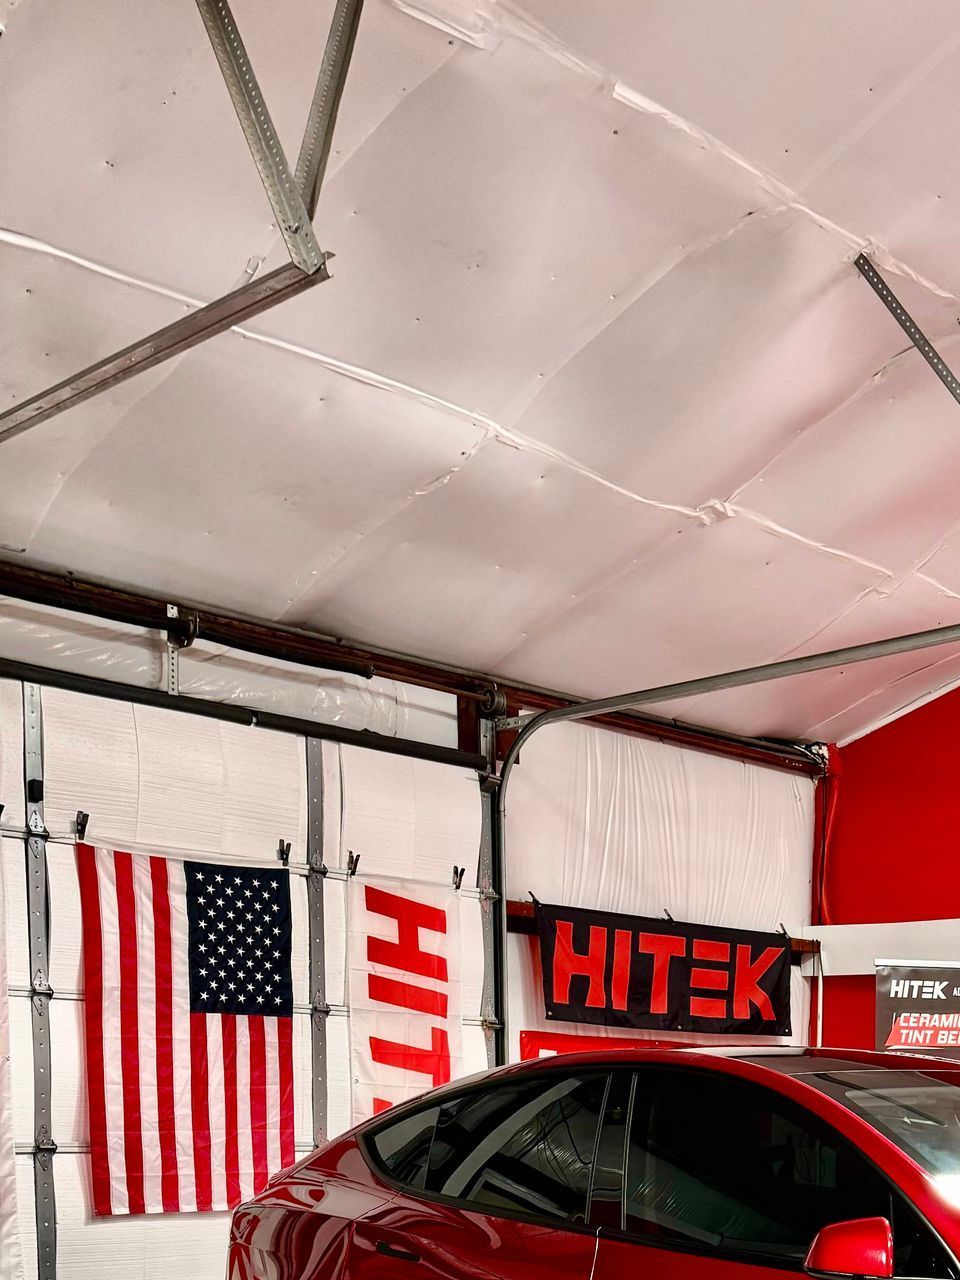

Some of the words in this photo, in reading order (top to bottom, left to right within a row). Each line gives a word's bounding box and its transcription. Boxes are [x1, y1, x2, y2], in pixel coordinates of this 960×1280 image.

[553, 920, 785, 1021] HITEK
[890, 979, 949, 1000] HITEK
[900, 1029, 935, 1045] TINT
